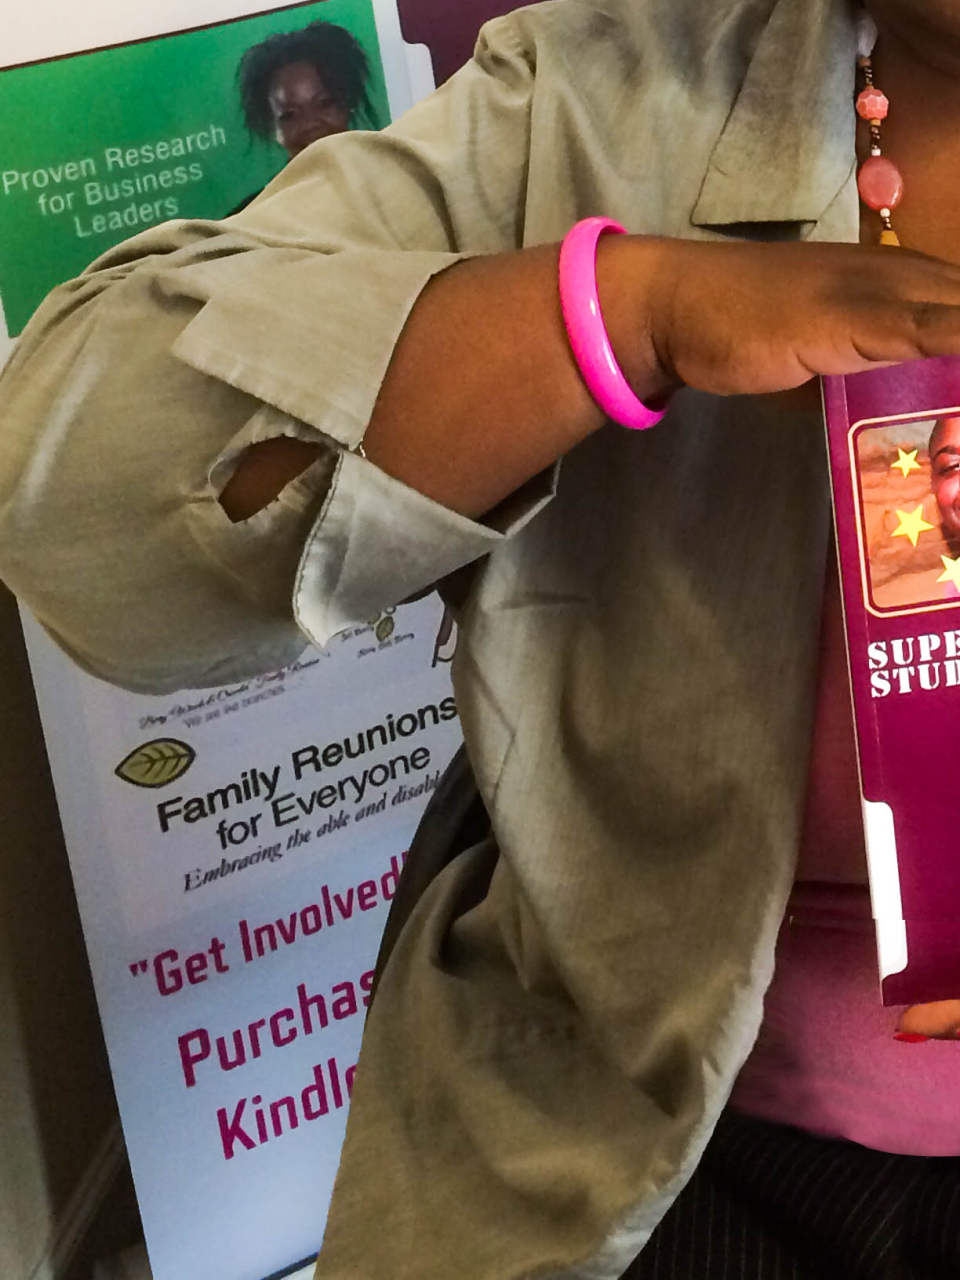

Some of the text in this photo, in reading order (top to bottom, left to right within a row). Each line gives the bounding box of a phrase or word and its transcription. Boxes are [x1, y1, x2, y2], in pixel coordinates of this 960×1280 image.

[2, 124, 226, 195] Proven Research
[38, 163, 203, 216] for Business
[75, 196, 179, 238] Leaders
[156, 765, 281, 833] Family
[291, 695, 458, 780] Reunions
[216, 746, 431, 850] for Everyone
[183, 841, 282, 893] Embracing
[287, 828, 312, 851] the
[316, 809, 350, 839] able
[354, 791, 387, 822] and
